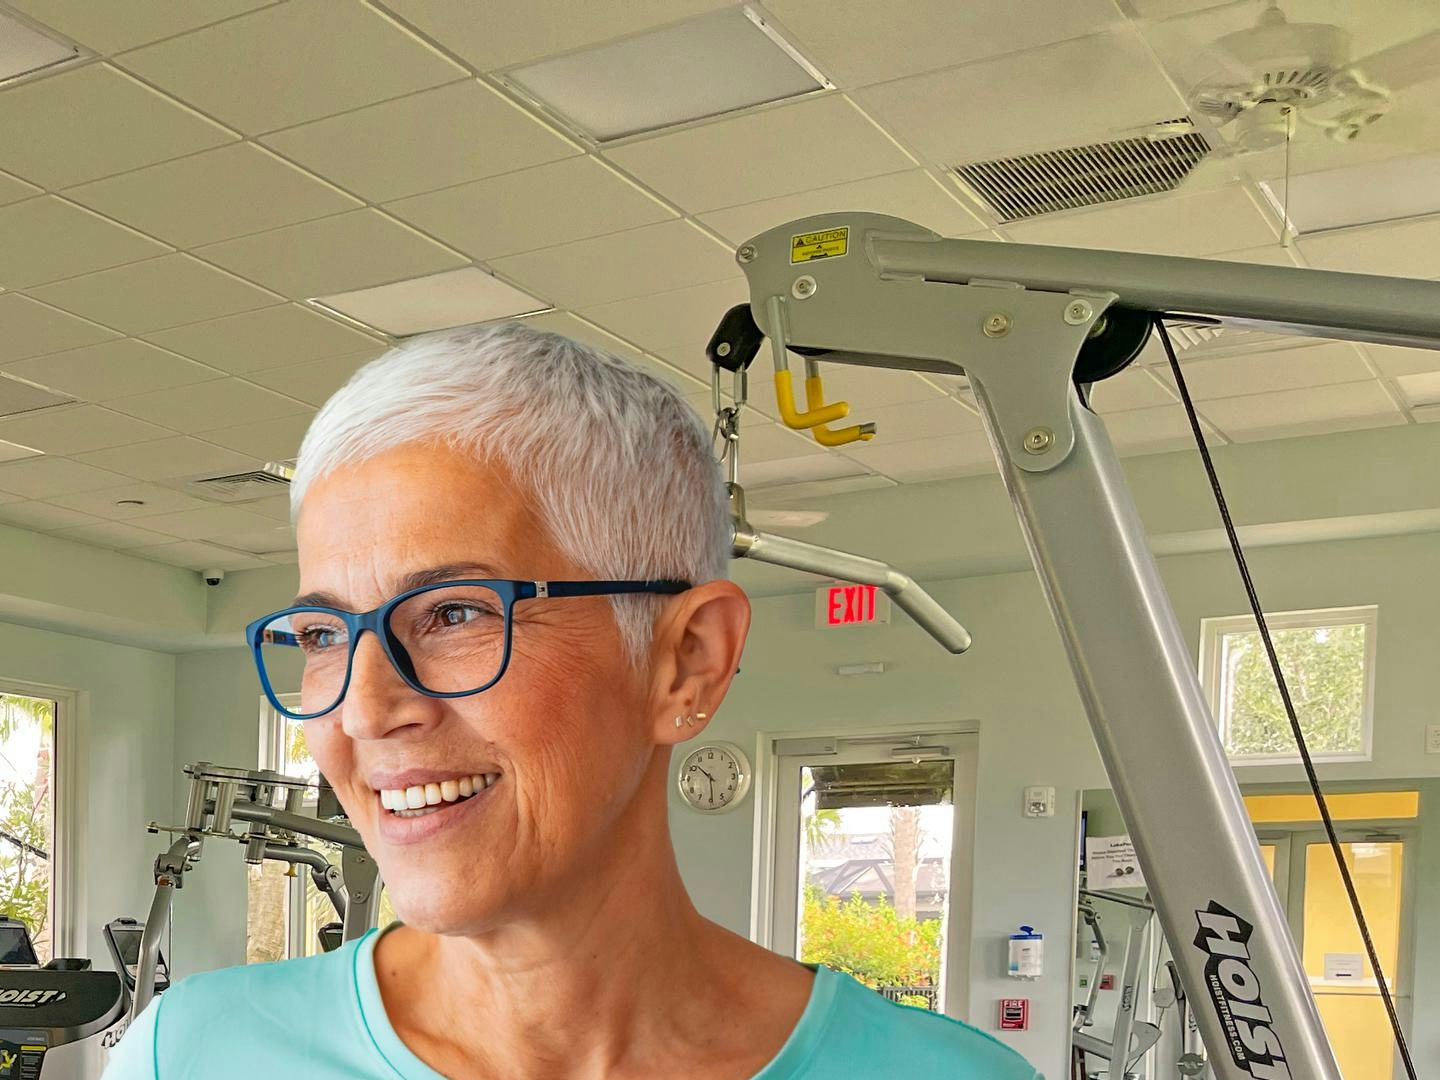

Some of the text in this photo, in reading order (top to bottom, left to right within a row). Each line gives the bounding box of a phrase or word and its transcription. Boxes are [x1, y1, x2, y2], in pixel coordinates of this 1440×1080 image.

[805, 231, 846, 243] CAUTION
[828, 585, 878, 625] EXIT
[1209, 974, 1246, 1061] HOISTFITNESS.COM
